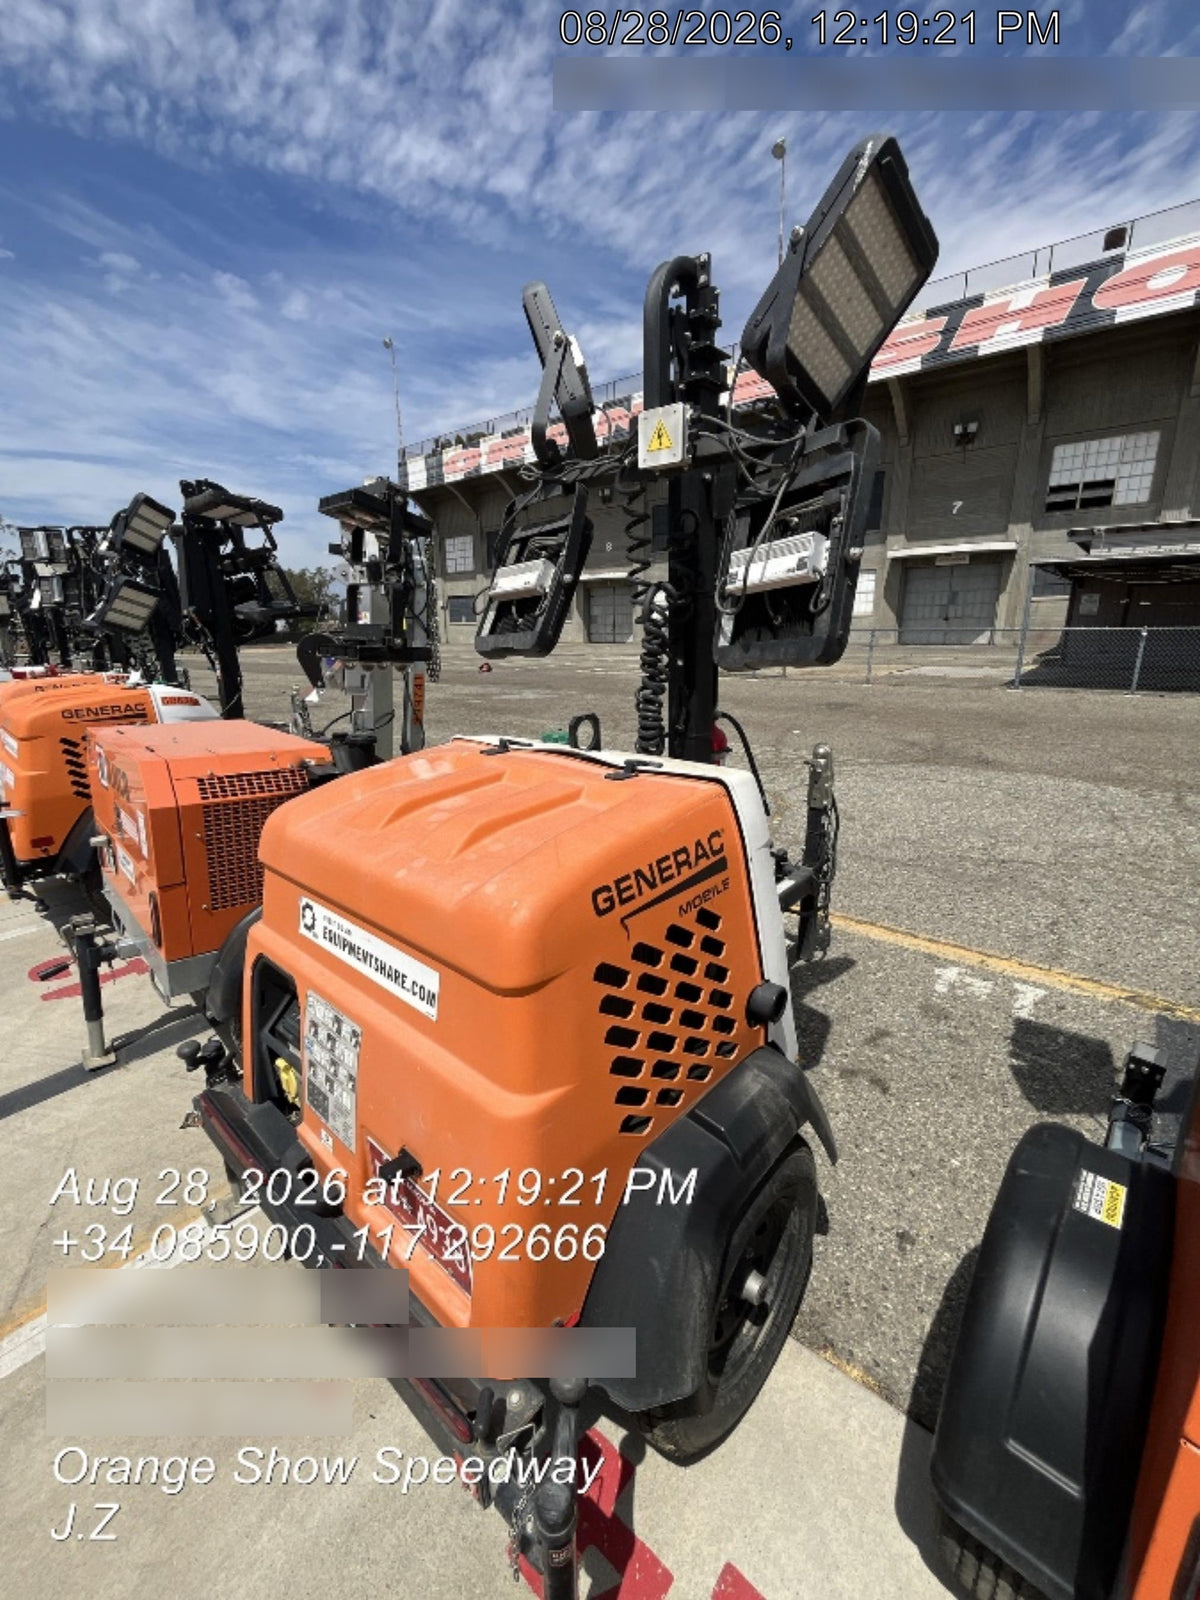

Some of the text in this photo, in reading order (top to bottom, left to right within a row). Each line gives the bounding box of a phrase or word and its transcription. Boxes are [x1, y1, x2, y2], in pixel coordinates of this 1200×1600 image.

[952, 500, 964, 515] 7
[61, 703, 146, 718] GENERAC
[592, 830, 725, 918] GENERAC
[678, 877, 731, 918] MOBILE
